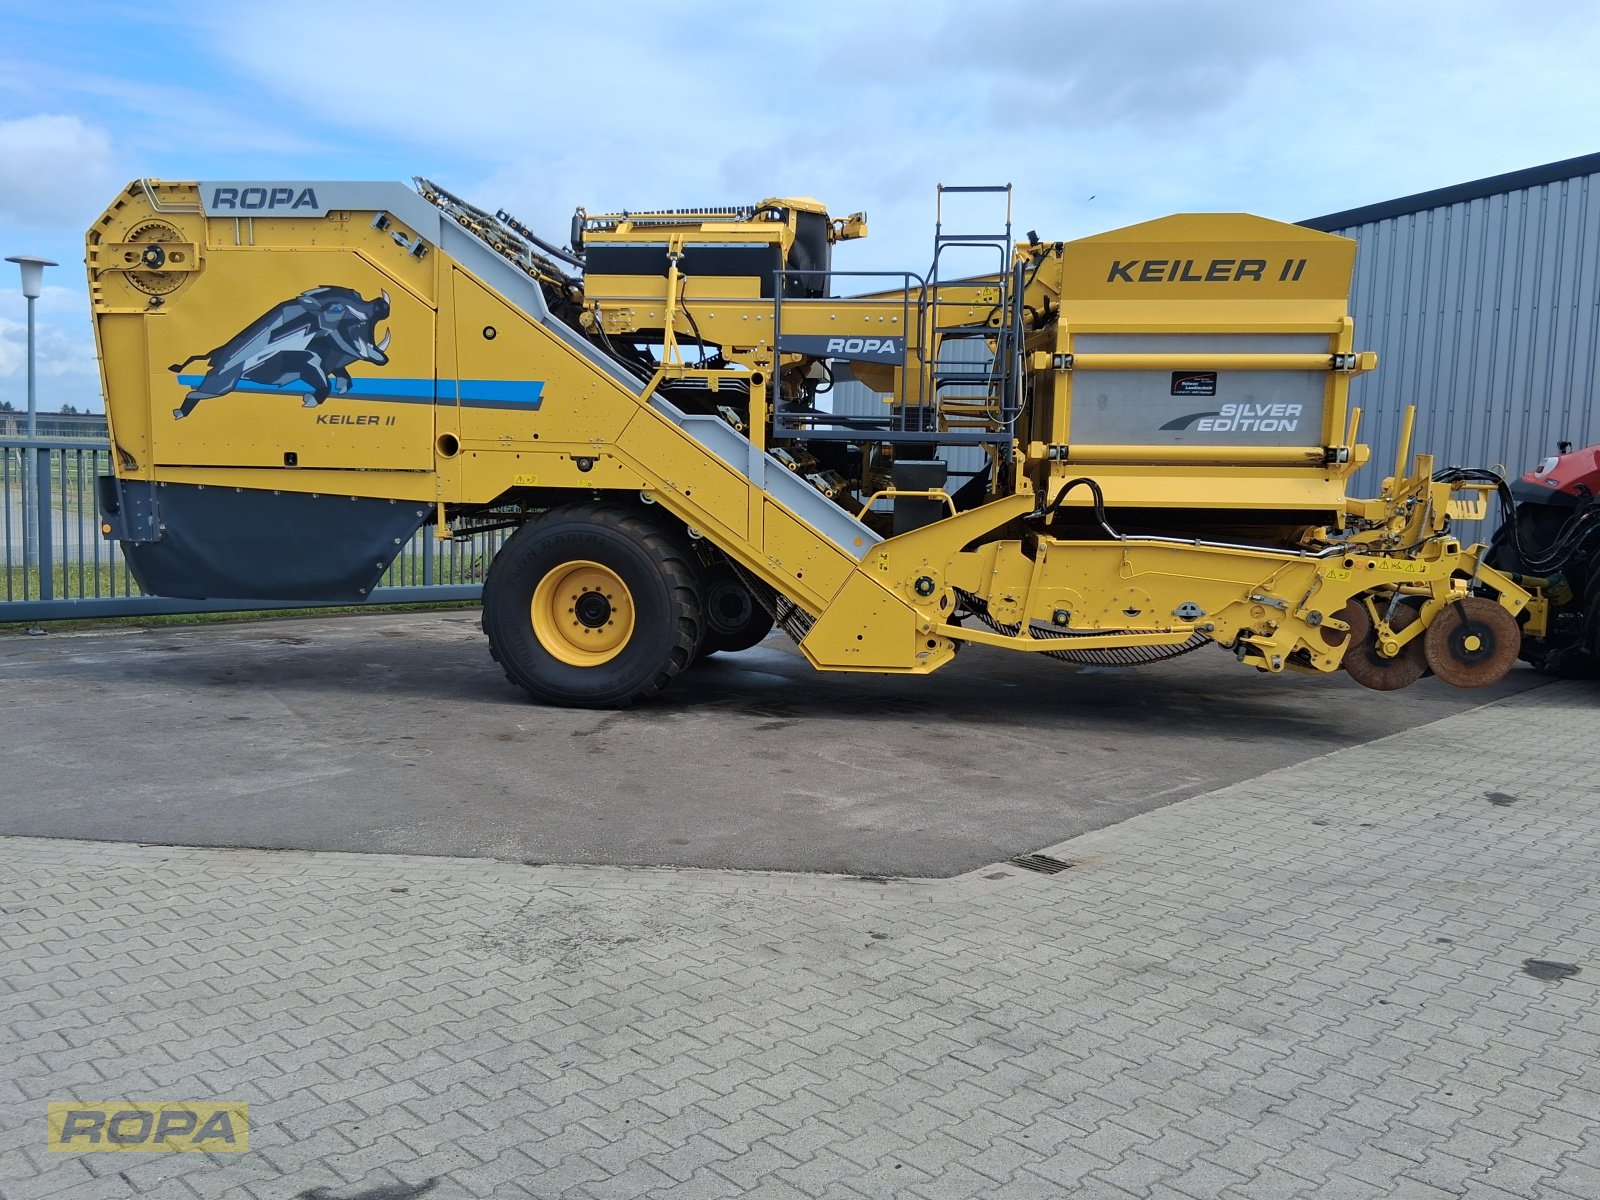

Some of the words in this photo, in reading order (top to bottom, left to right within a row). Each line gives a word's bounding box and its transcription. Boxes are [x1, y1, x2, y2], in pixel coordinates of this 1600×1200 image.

[211, 187, 319, 210] ROPA
[1106, 259, 1267, 283] KEILER
[1278, 258, 1307, 282] II
[826, 338, 896, 354] ROPA
[1219, 403, 1303, 417] SILVER
[316, 414, 380, 426] KEILER
[385, 415, 396, 426] II
[1197, 419, 1299, 432] EDITION
